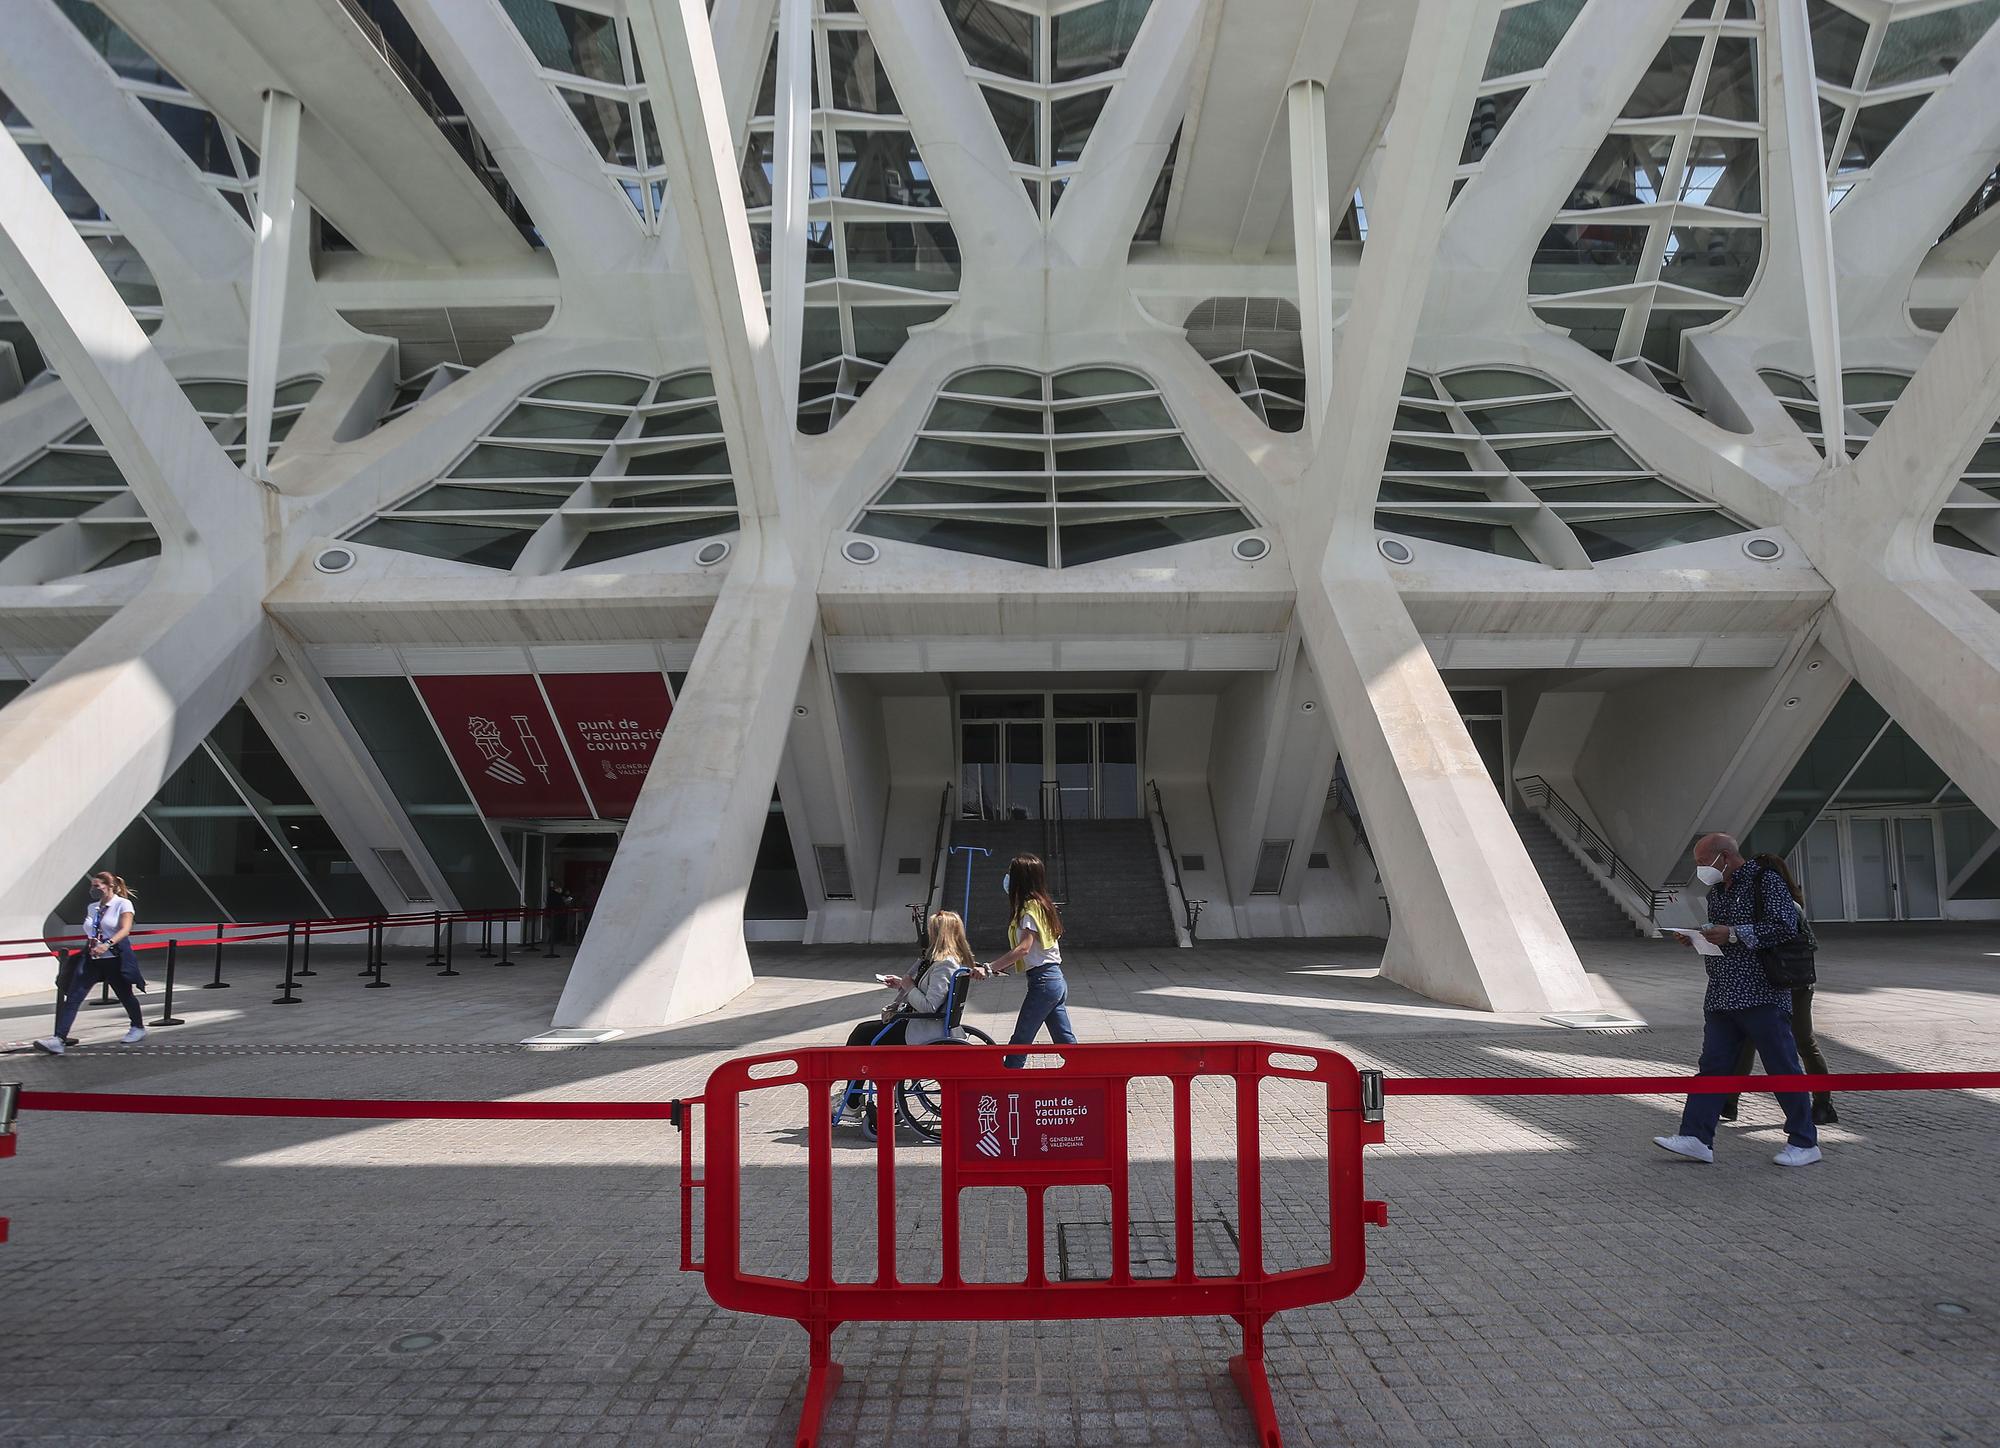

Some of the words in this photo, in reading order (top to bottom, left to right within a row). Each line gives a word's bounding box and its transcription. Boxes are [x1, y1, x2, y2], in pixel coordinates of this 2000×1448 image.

[577, 719, 615, 732] punt
[619, 718, 639, 730] de
[587, 741, 647, 751] COVID19
[1035, 1097, 1058, 1109] punt
[1061, 1096, 1074, 1106] de
[1035, 1105, 1088, 1117] vacunació
[1035, 1117, 1075, 1126] COVID19
